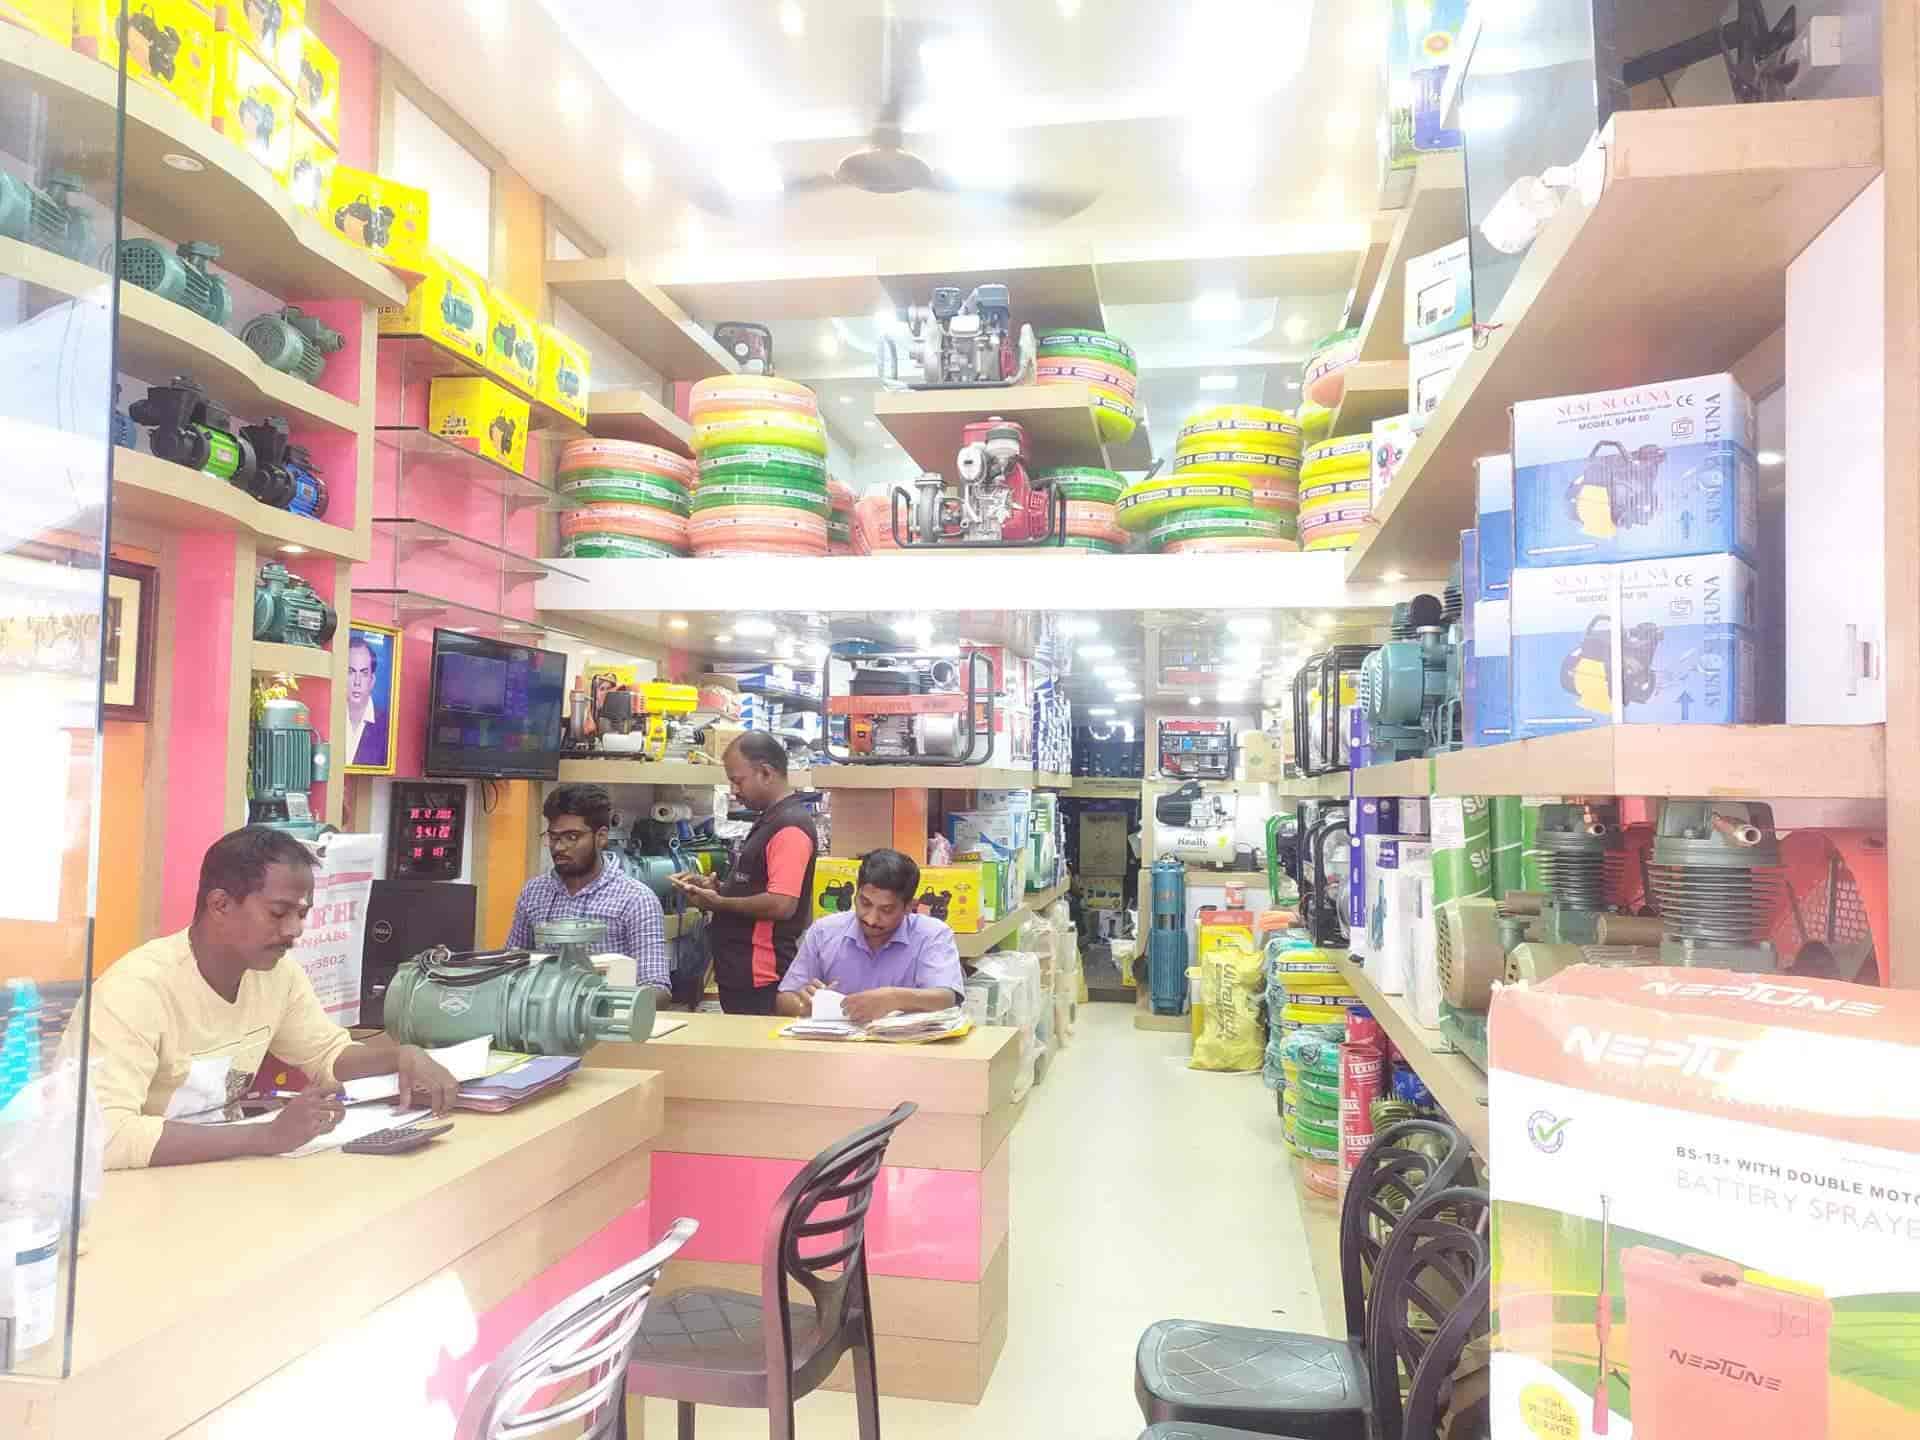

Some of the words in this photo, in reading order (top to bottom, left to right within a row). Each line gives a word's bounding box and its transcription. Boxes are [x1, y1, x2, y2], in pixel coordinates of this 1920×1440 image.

[1578, 419, 1611, 431] MODEL
[1640, 980, 1886, 1016] NEPTUNE
[1675, 1145, 1731, 1168] BS-13+
[1737, 1158, 1782, 1178] WITH
[1786, 1168, 1864, 1196] DOUBLE
[1675, 1169, 1801, 1214] BATTERY
[1668, 1348, 1784, 1392] NEPTUNE
